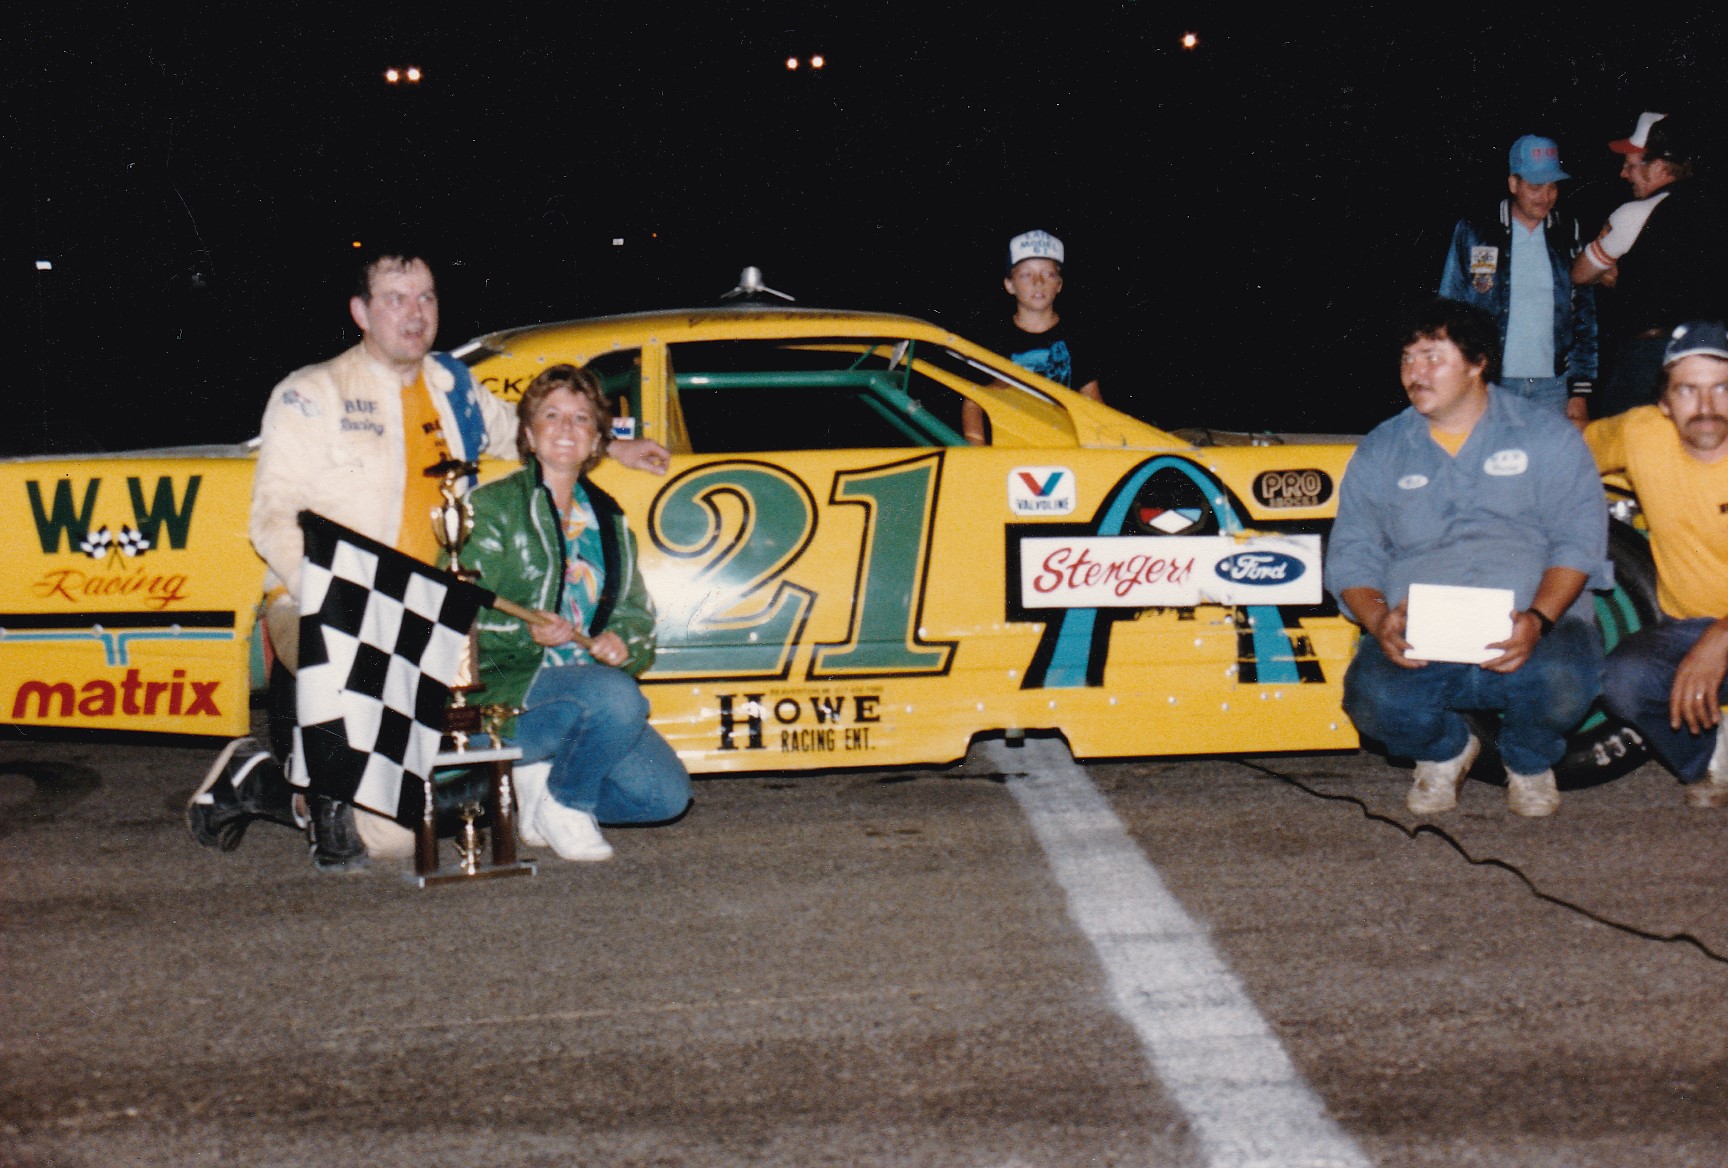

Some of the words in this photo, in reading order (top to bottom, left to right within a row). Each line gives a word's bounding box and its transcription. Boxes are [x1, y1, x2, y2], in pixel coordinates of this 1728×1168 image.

[1261, 471, 1322, 500] PRO
[1016, 498, 1069, 511] VALVOLINE
[638, 450, 960, 684] 21
[1231, 554, 1287, 580] Ford
[32, 565, 188, 610] Racing
[12, 669, 222, 718] matrix
[715, 693, 882, 750] HOWE
[781, 728, 835, 752] RACING
[845, 727, 876, 751] ENT.
